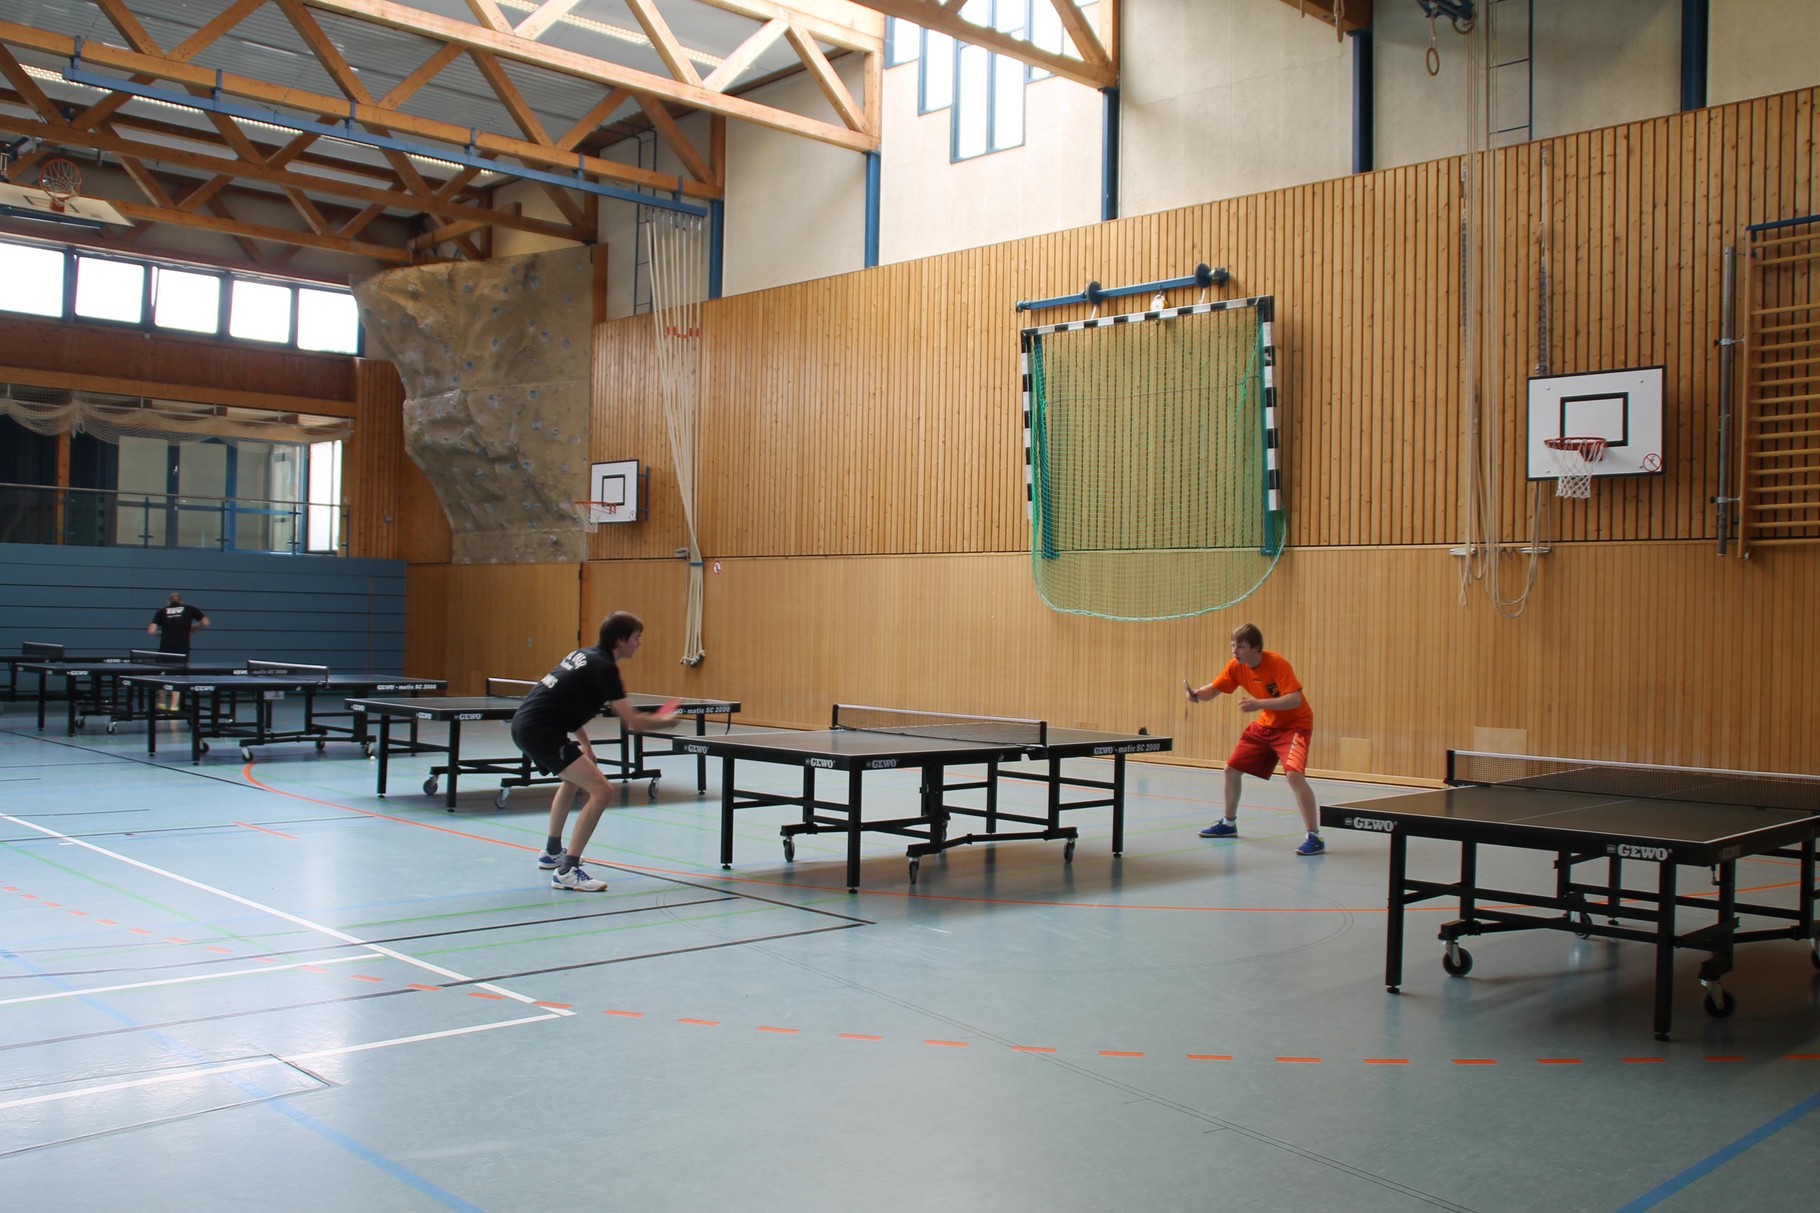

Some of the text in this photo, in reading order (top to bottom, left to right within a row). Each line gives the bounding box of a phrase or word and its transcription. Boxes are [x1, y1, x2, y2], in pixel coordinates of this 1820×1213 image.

[714, 705, 731, 713] 2000
[1136, 743, 1145, 752] SC
[1145, 743, 1160, 752] 2000
[810, 757, 834, 769] GEWO
[871, 758, 897, 769] GEWO
[1353, 816, 1394, 832] GEWO
[1617, 843, 1668, 861] GEWO
